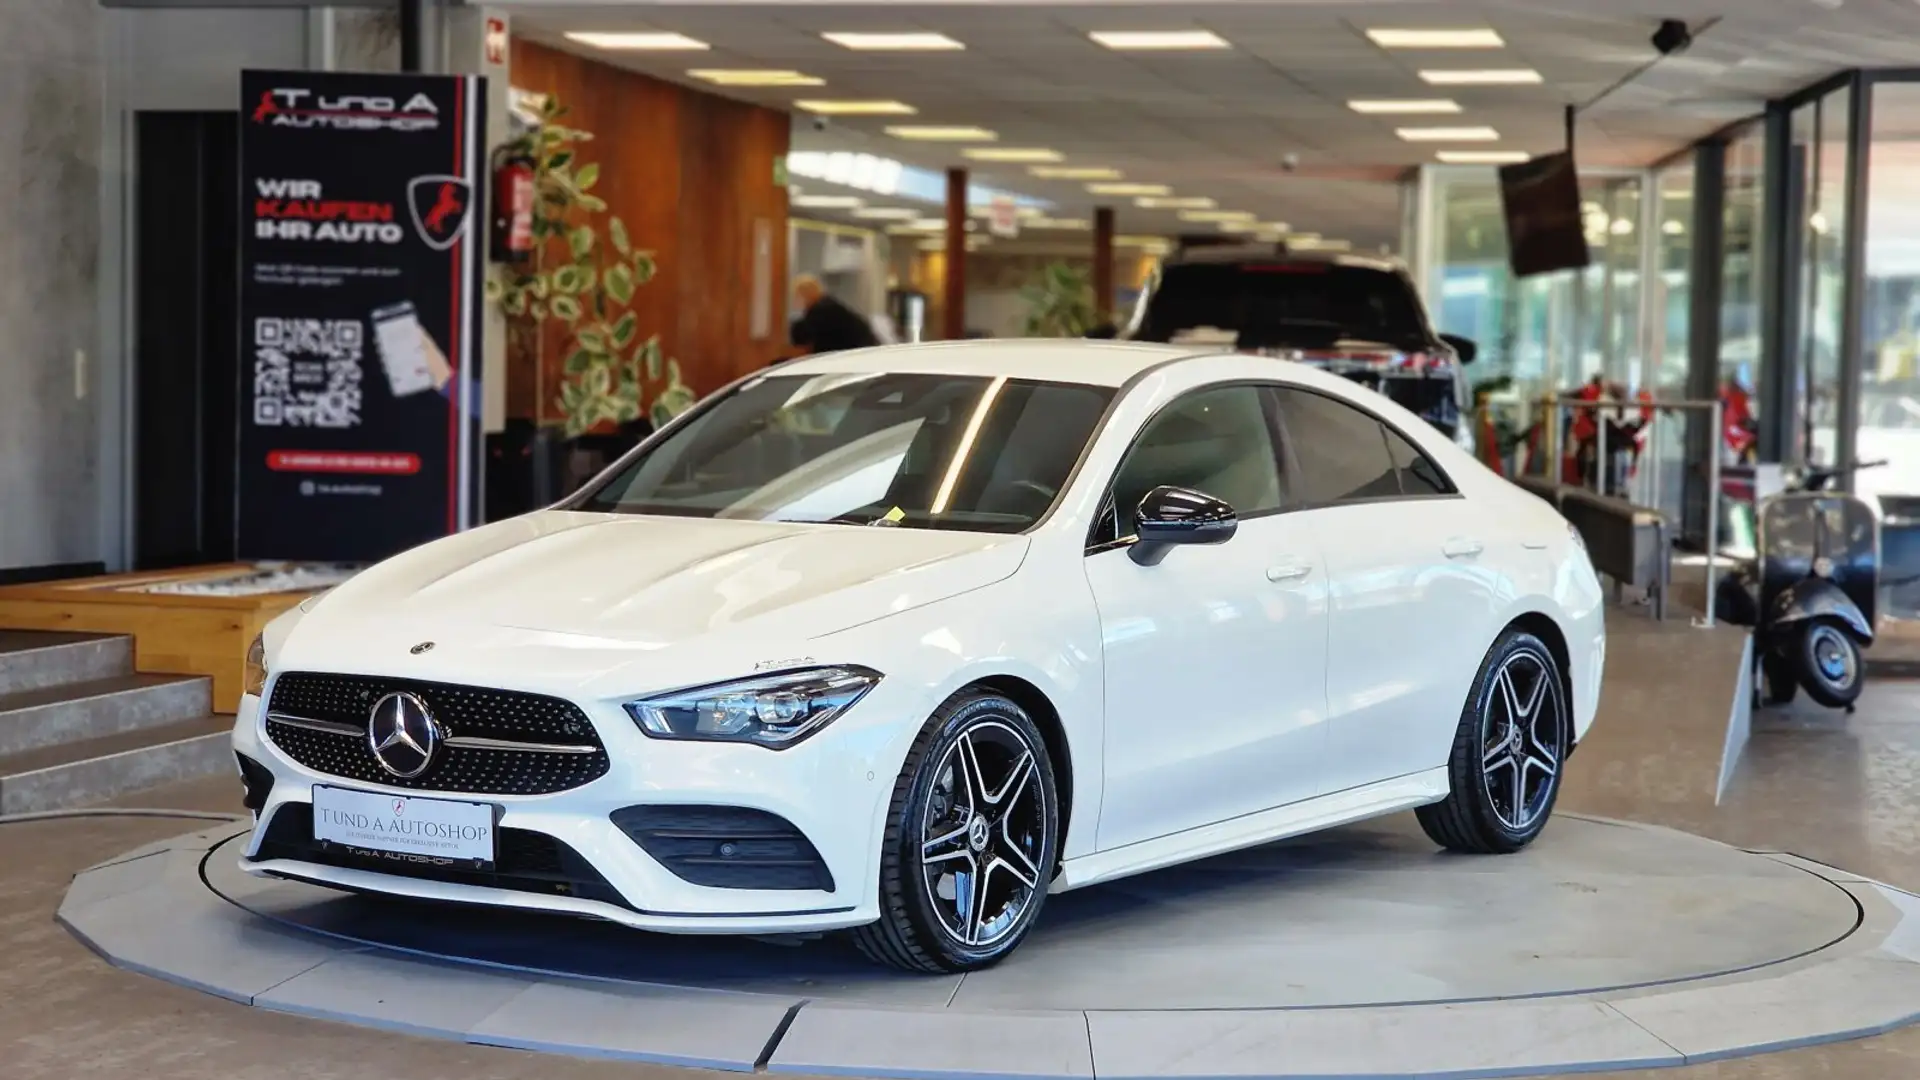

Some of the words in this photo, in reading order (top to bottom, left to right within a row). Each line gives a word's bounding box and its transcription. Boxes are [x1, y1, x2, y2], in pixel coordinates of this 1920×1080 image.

[272, 88, 311, 109] T
[402, 91, 439, 114] A
[272, 113, 440, 131] AUTOSHOP
[255, 178, 322, 199] WIR
[255, 199, 393, 221] KAUFEN
[255, 218, 312, 241] IHR
[314, 219, 403, 244] AUTO
[321, 807, 331, 823] T
[333, 811, 369, 829] UND
[372, 816, 385, 832] A
[387, 818, 488, 842] AUTOSHOP
[384, 851, 454, 866] AUTOSHOP
